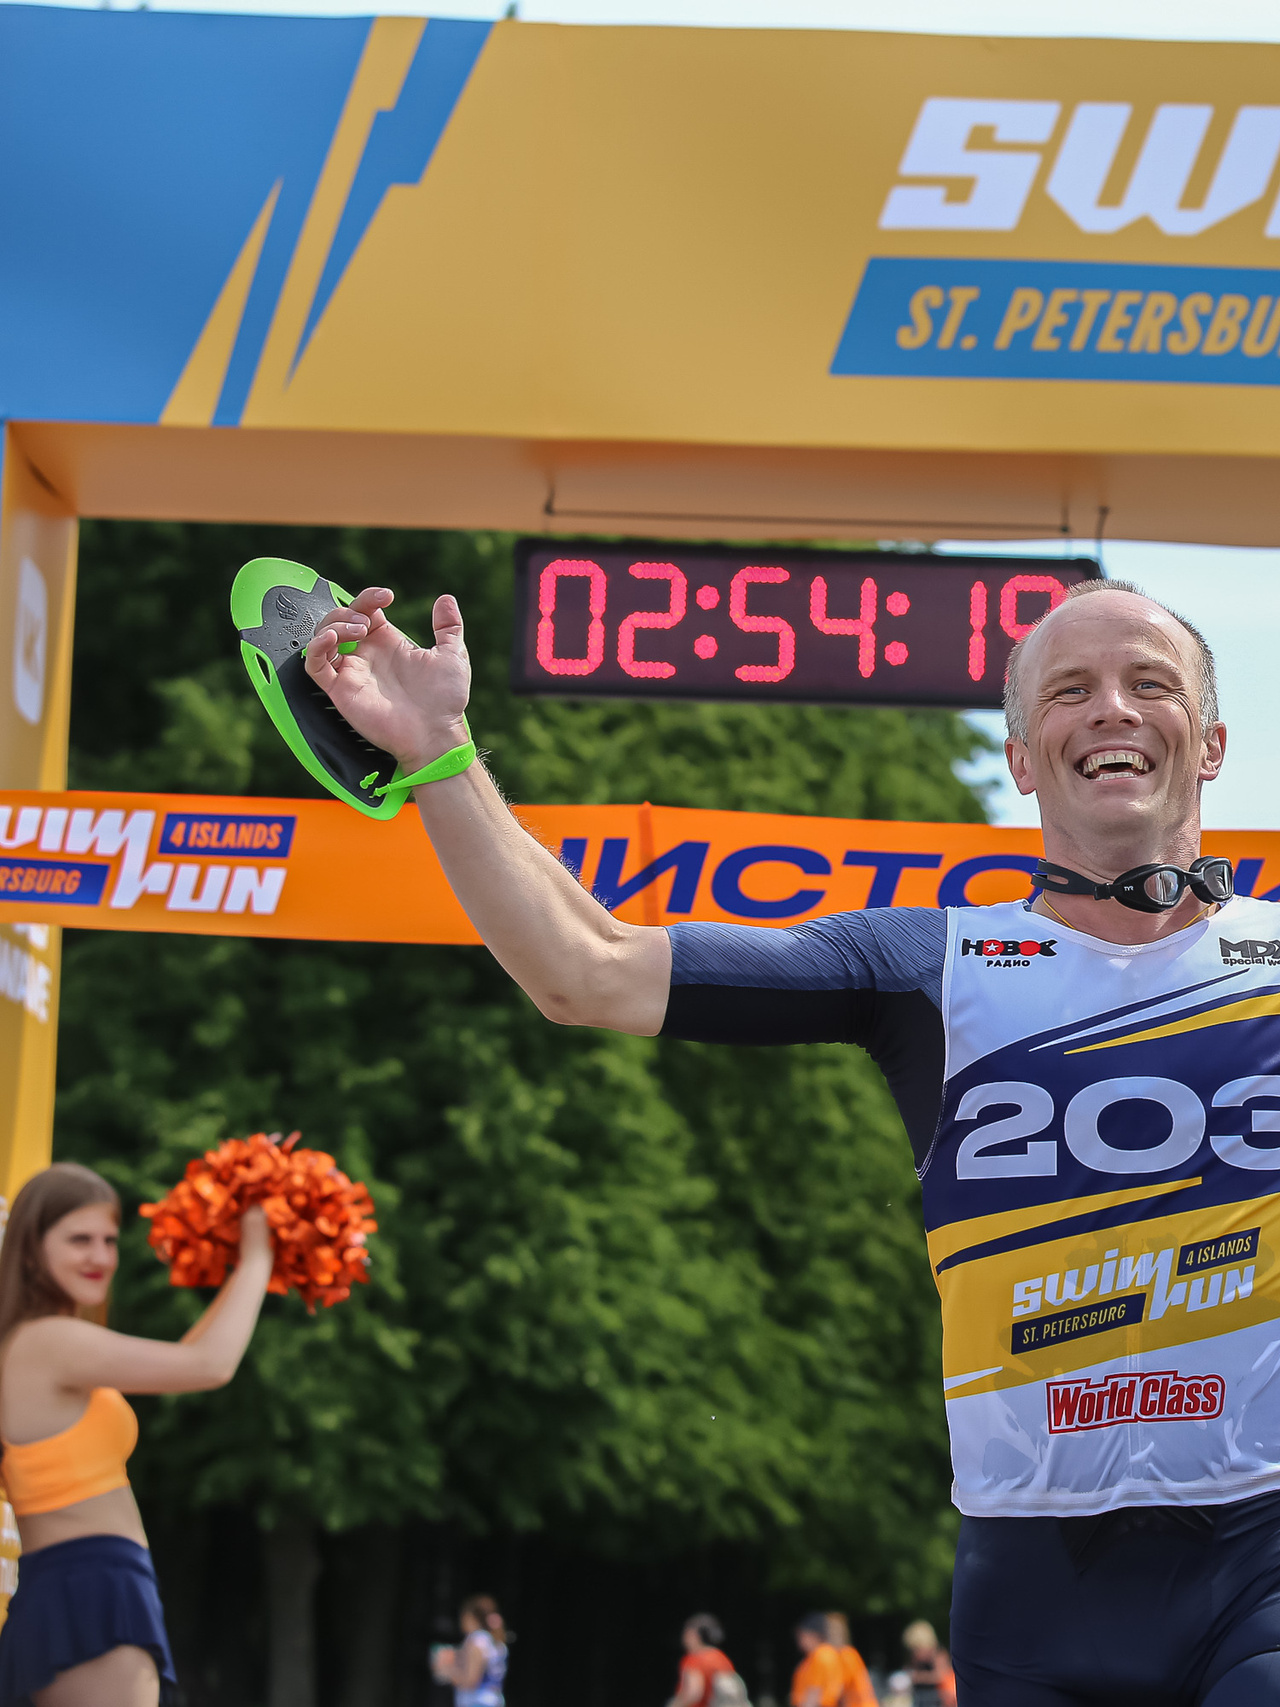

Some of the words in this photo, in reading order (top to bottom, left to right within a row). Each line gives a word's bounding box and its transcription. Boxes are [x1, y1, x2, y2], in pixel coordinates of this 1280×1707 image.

[896, 285, 979, 351] ST.
[170, 822, 187, 847] 4
[187, 822, 284, 850] ISLANDS
[0, 866, 82, 895] RSBURG
[561, 837, 1044, 920] ИСТО
[986, 959, 1030, 968] РАДИО
[1223, 955, 1265, 966] special
[1185, 1250, 1194, 1266] 4
[1198, 1235, 1252, 1264] ISLANDS
[1022, 1327, 1039, 1344] ST.
[1042, 1303, 1127, 1340] PETERSBURG
[1052, 1379, 1137, 1427] World
[1139, 1377, 1219, 1417] Class
